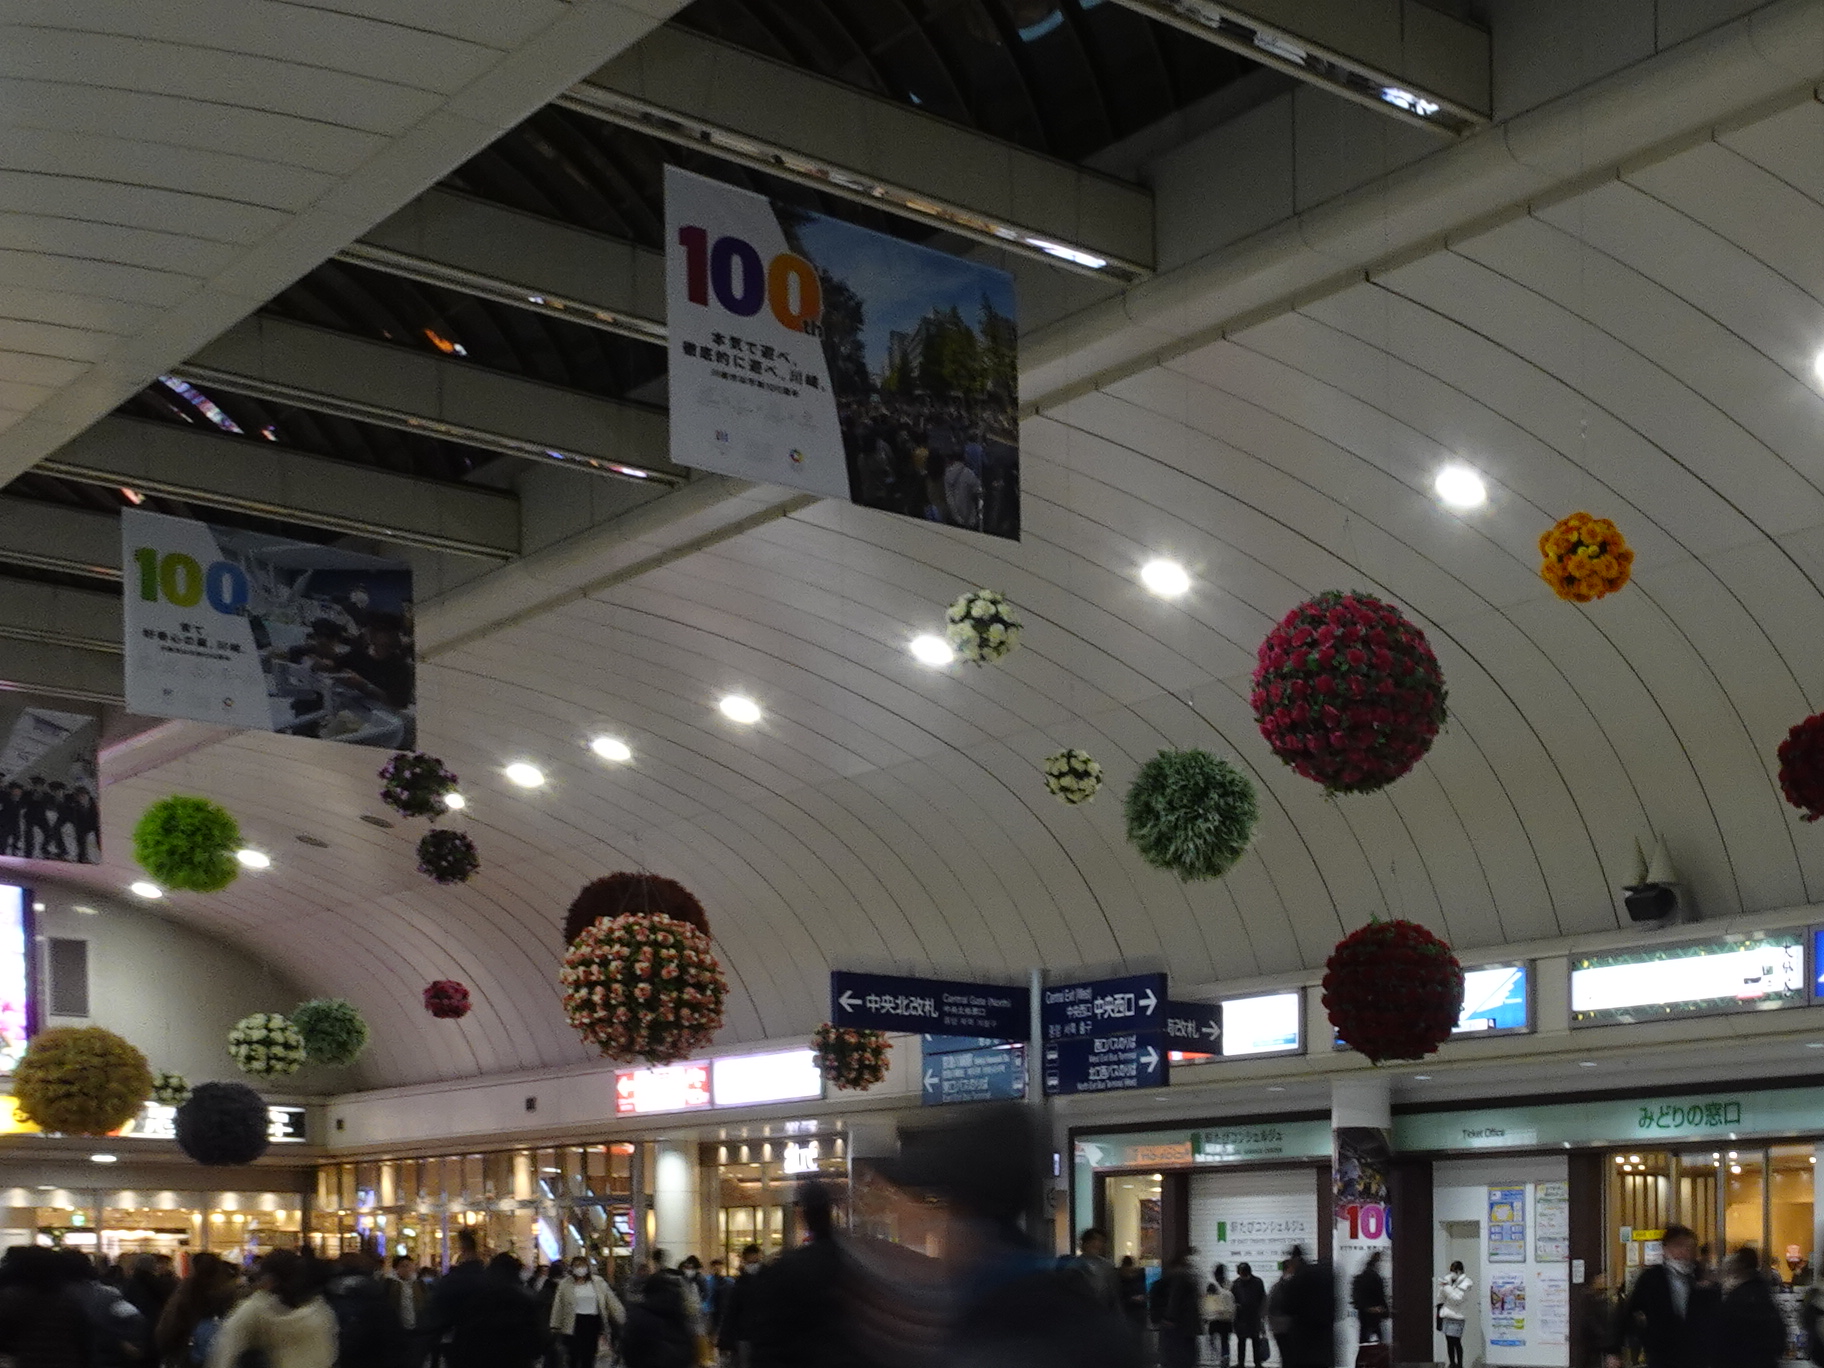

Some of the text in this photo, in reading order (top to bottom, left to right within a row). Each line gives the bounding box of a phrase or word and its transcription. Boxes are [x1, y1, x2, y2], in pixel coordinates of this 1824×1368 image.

[865, 993, 939, 1018] 中央北改札
[1093, 993, 1135, 1020] 中央西口
[1638, 1101, 1741, 1129] みどりの窓口
